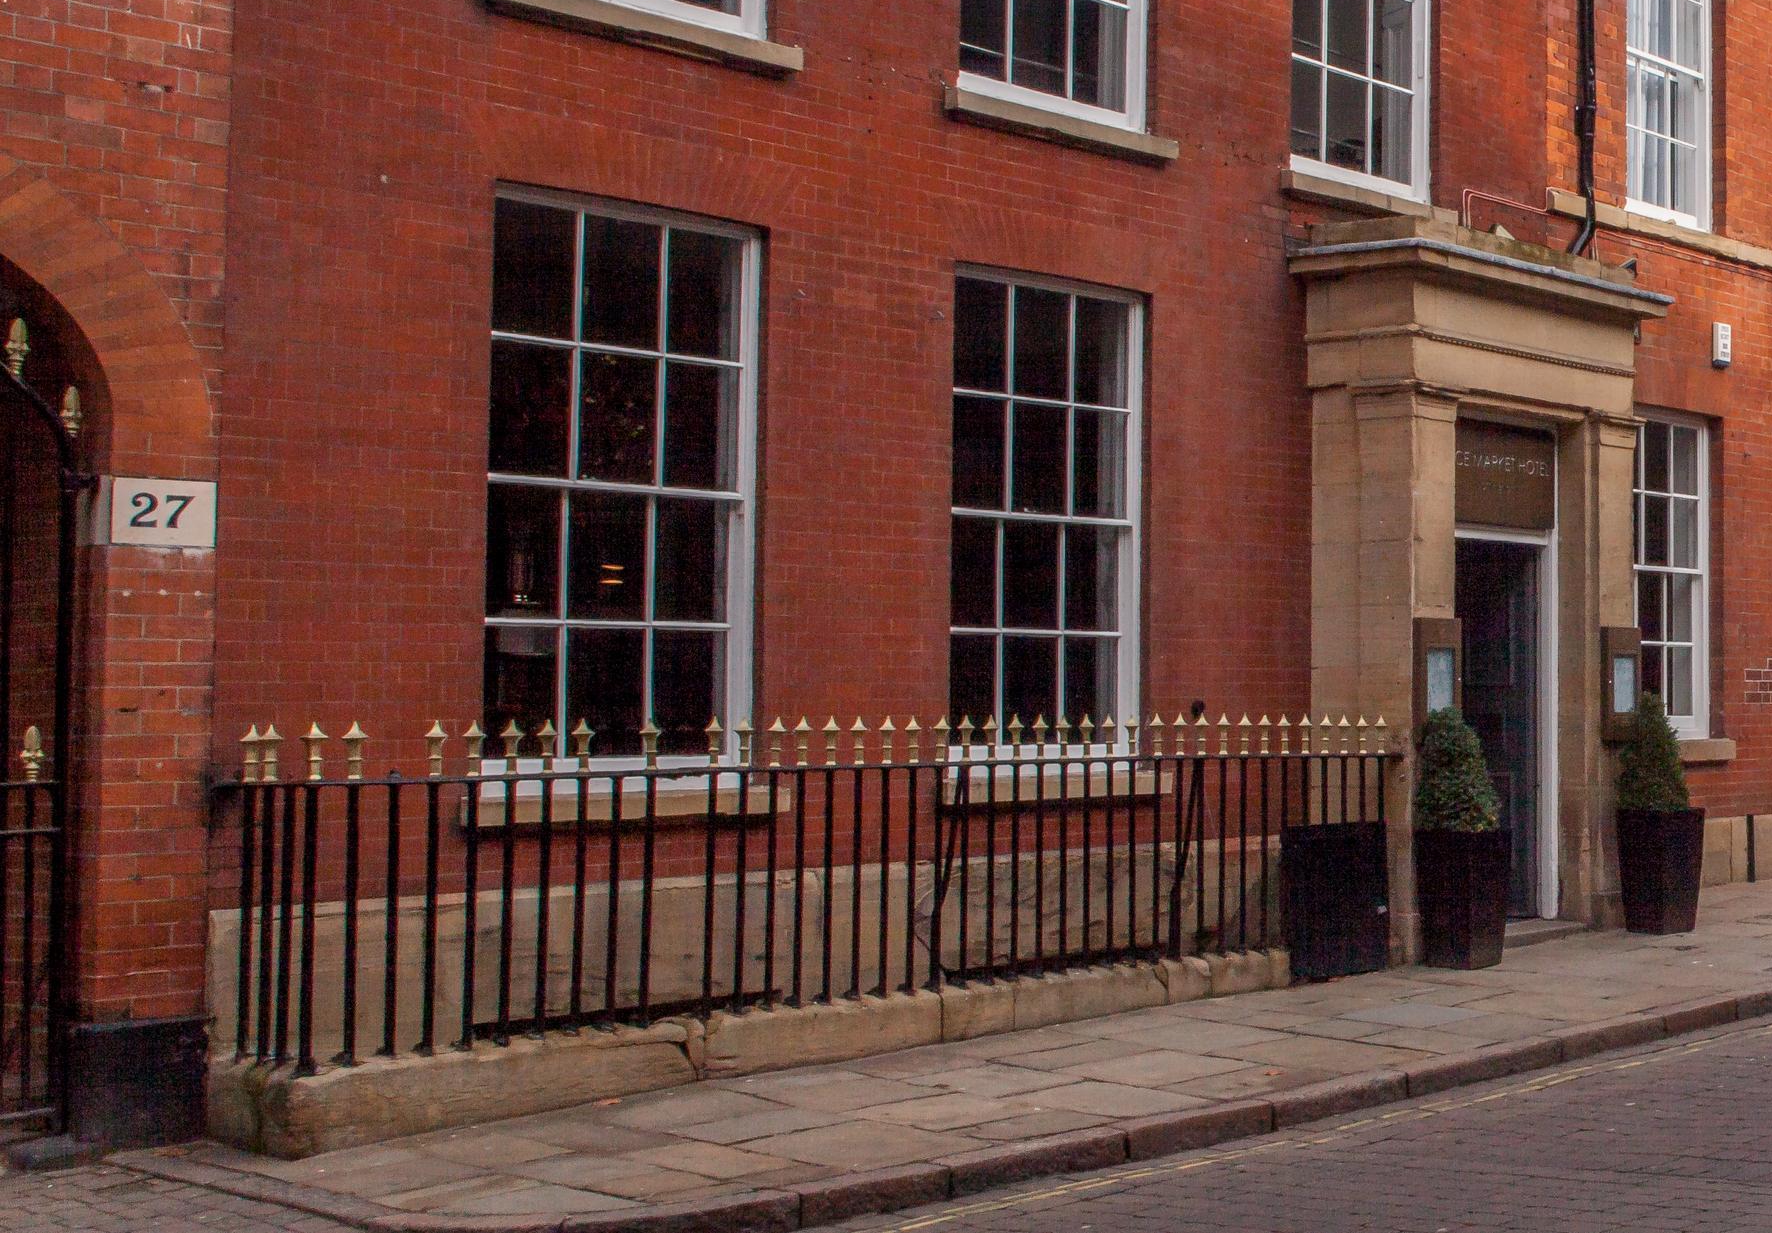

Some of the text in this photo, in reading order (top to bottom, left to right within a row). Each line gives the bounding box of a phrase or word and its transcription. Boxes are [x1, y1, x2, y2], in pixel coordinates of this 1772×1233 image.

[1473, 454, 1516, 473] MARKET
[1519, 459, 1551, 477] HOTEL
[128, 492, 196, 528] 27
